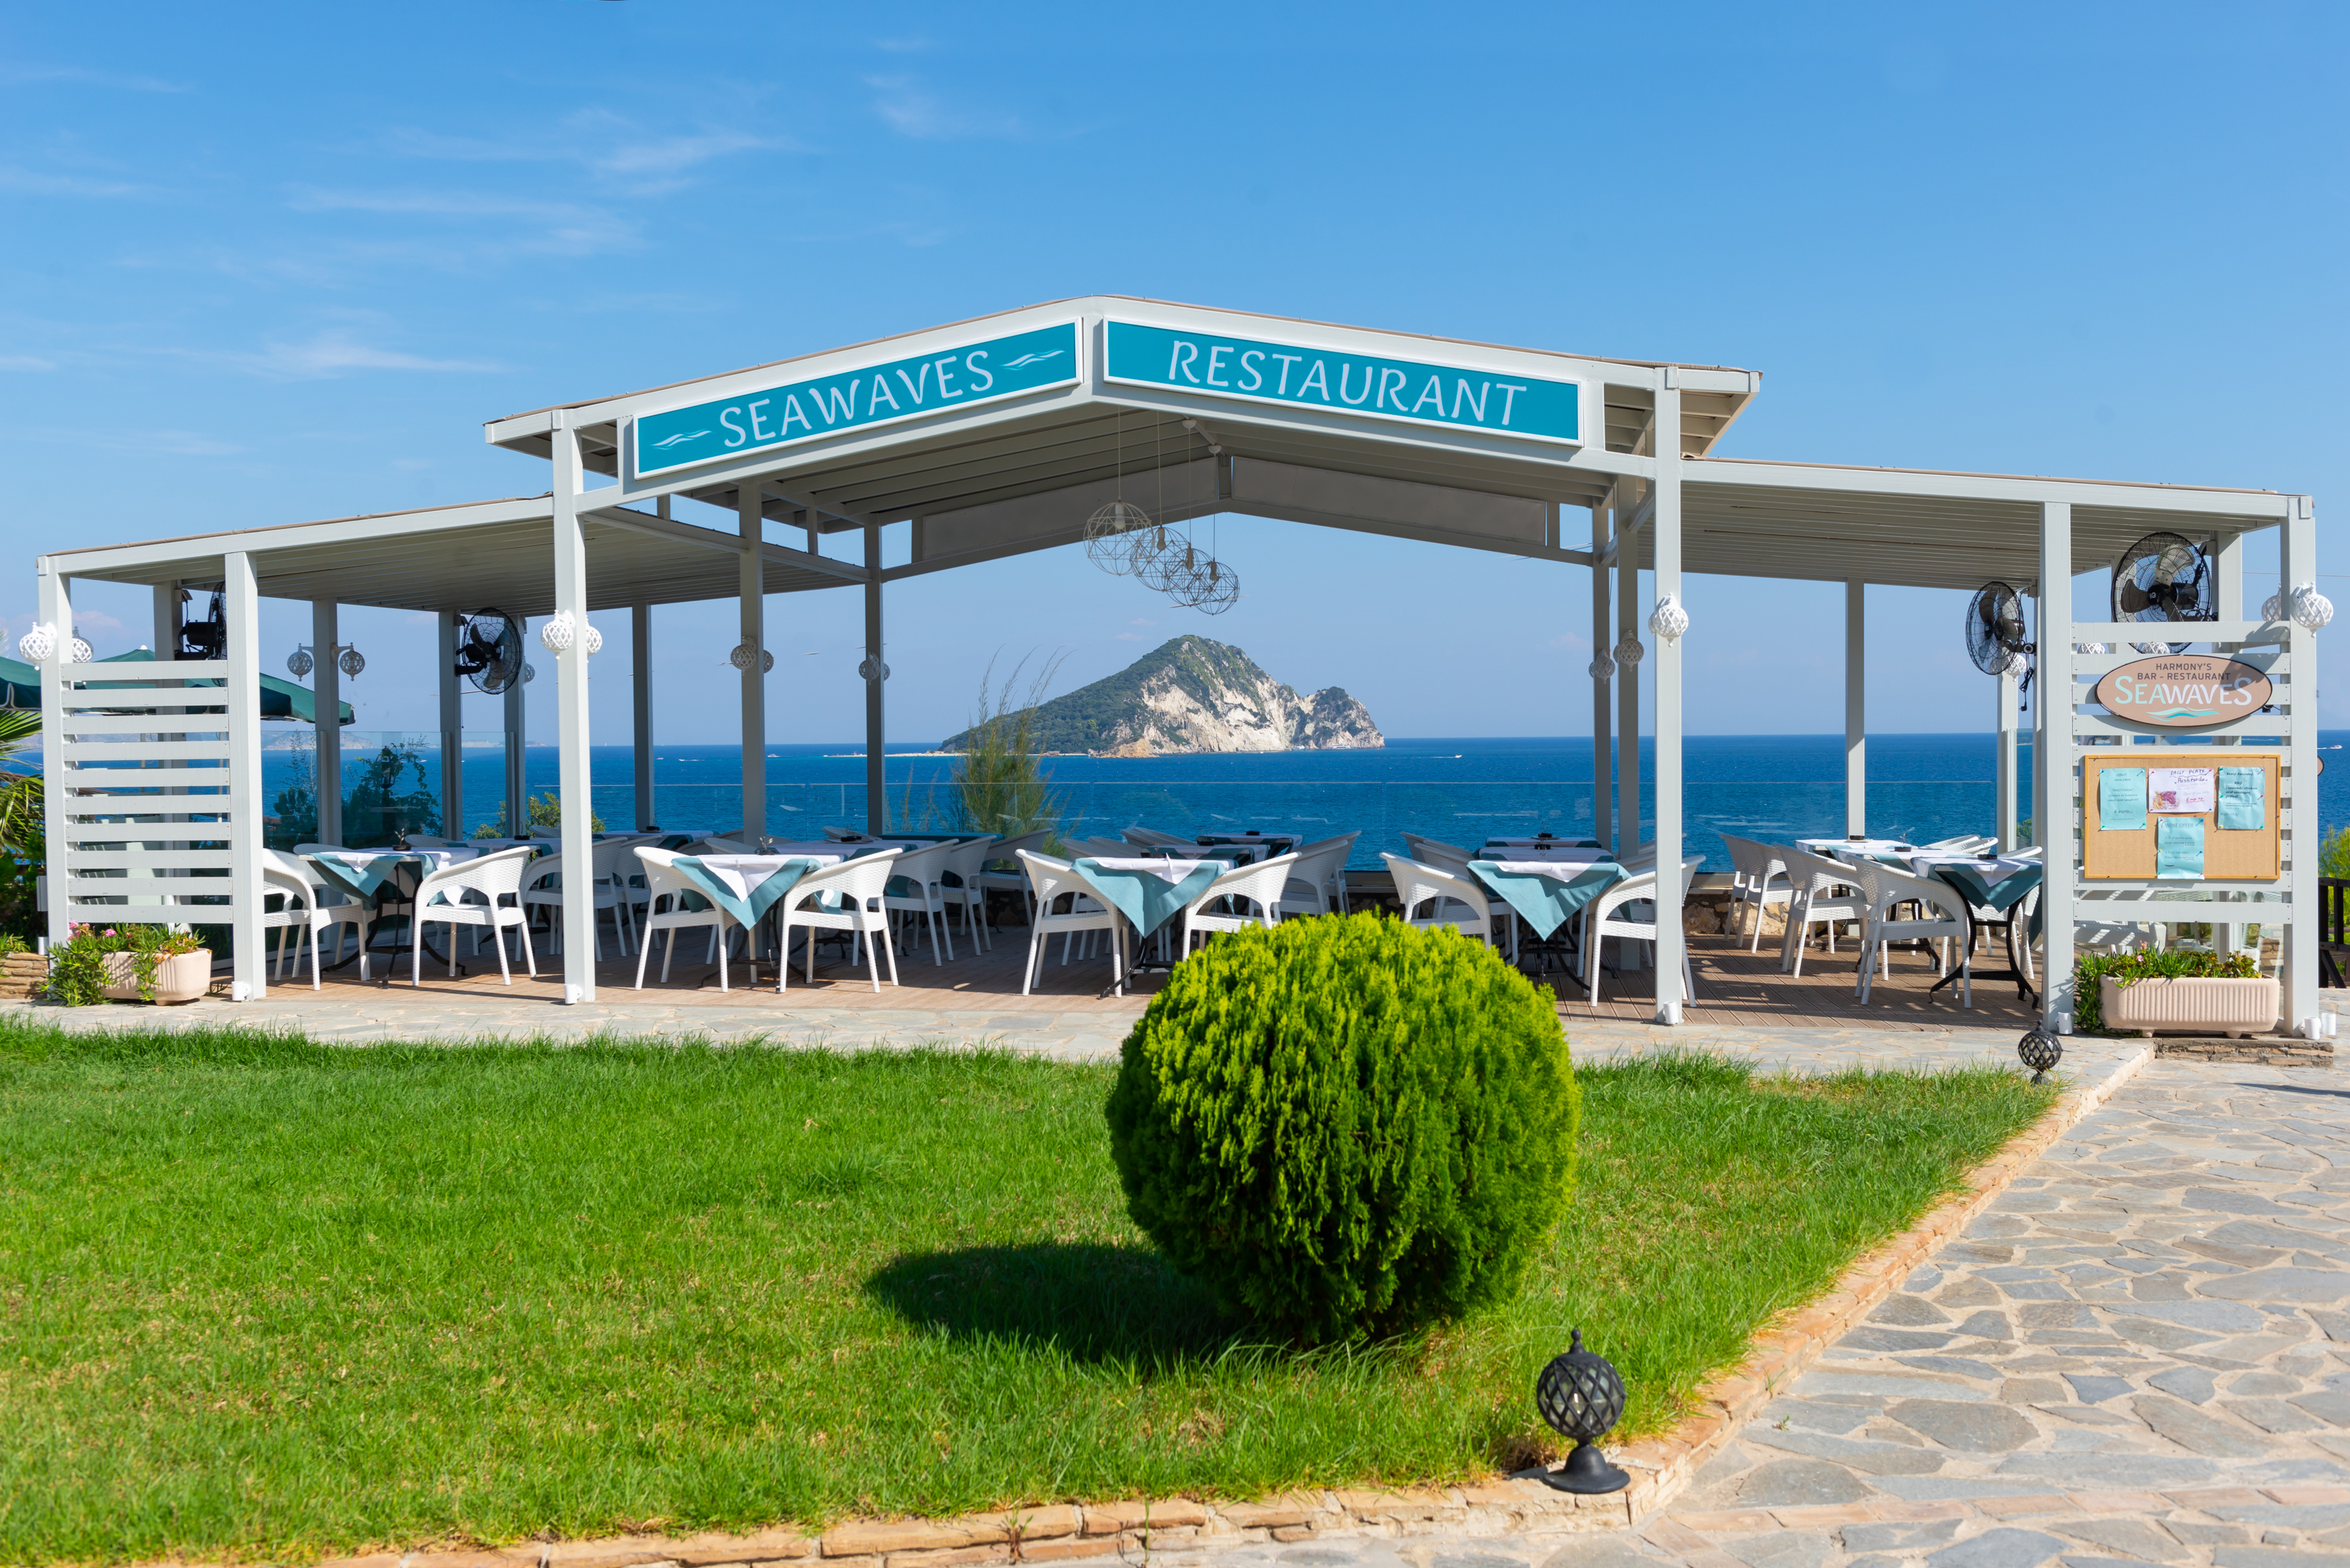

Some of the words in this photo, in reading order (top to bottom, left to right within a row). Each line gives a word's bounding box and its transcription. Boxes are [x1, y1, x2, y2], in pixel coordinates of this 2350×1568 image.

[719, 350, 993, 447] SEAWAVES
[1168, 340, 1527, 426] RESTAURANT
[2115, 675, 2252, 706] SEAWAVES
